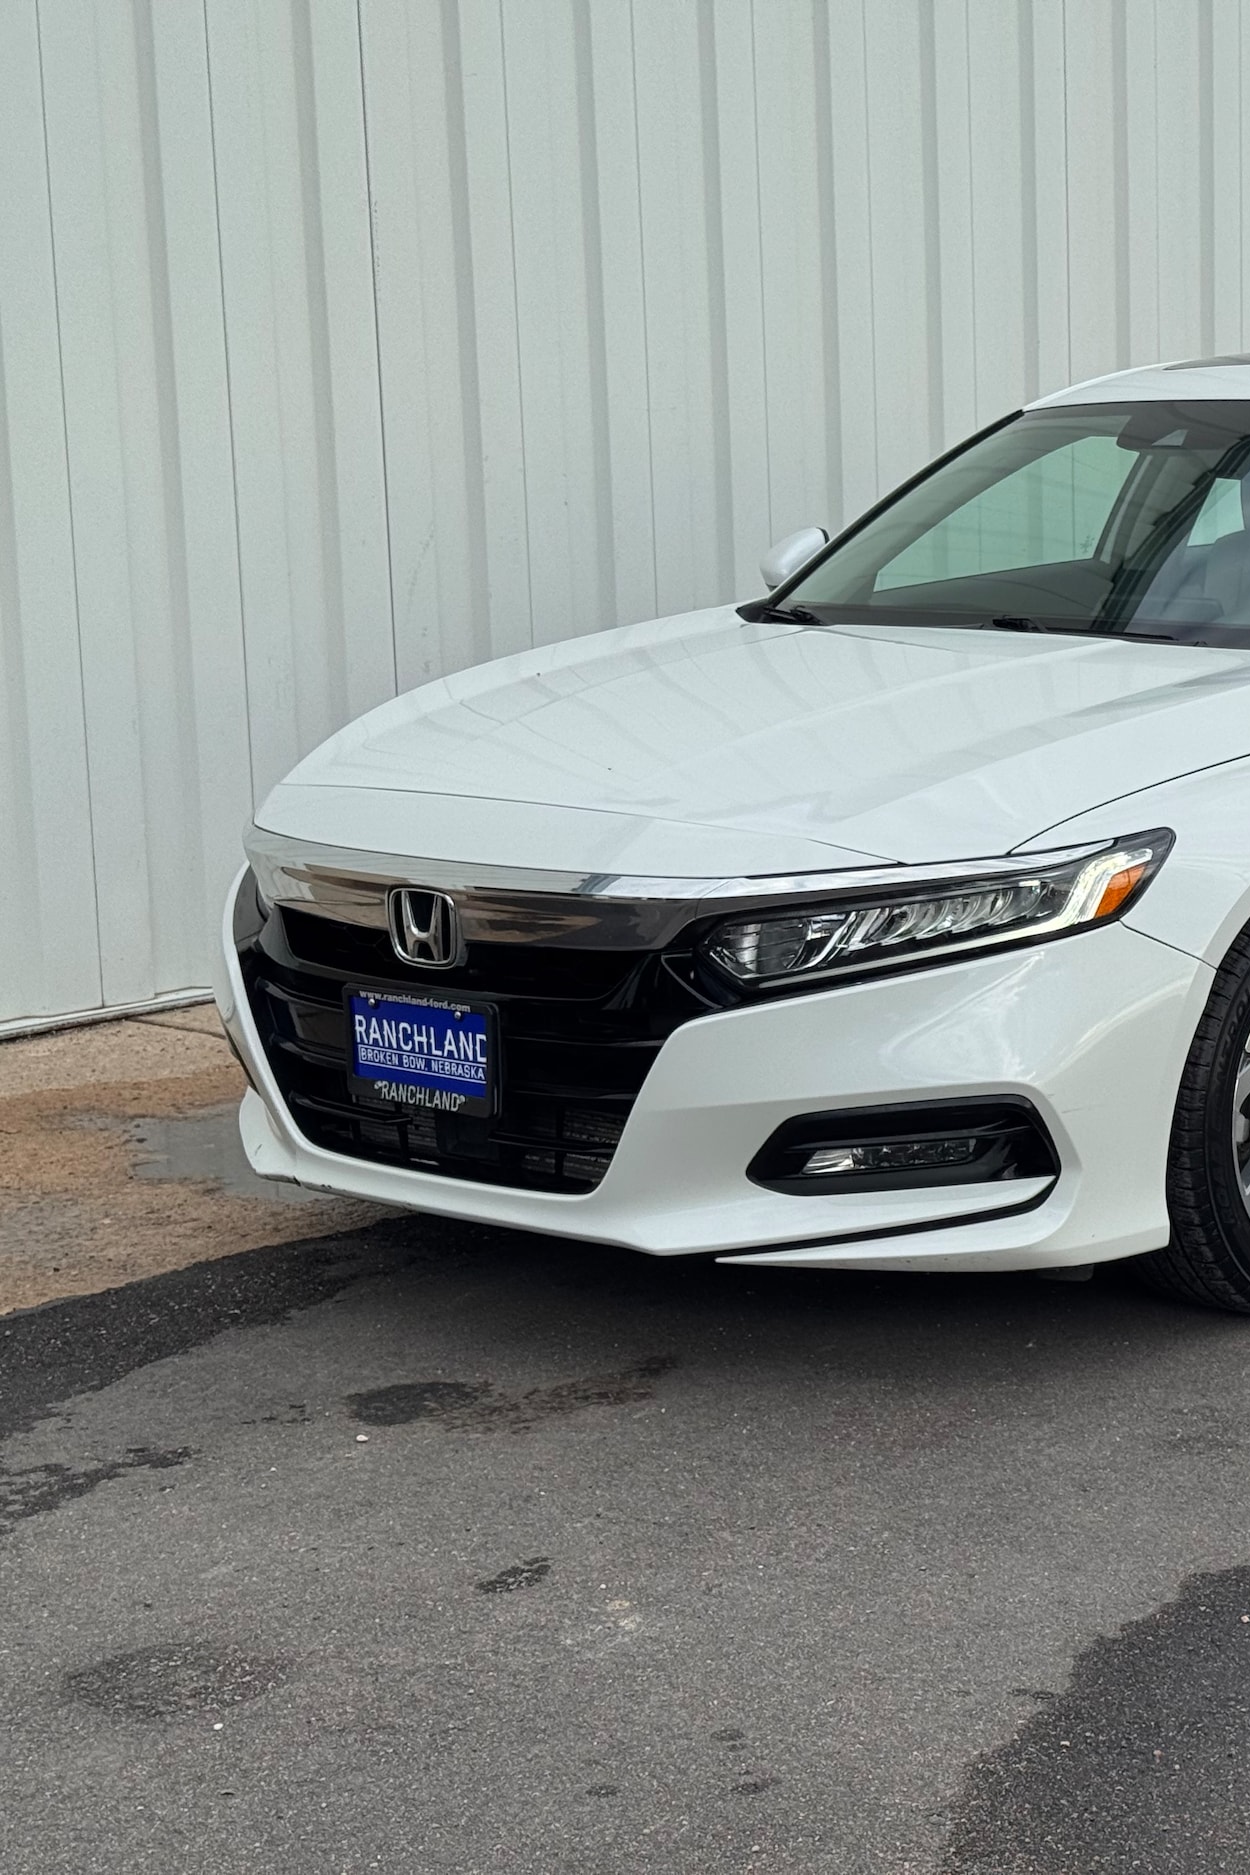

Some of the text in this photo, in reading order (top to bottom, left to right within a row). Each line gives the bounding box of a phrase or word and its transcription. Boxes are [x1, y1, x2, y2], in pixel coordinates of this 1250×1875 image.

[359, 990, 471, 1012] www.ranchland-ford.com
[354, 1015, 487, 1062] RANCHLAND
[361, 1048, 399, 1065] BROKEN
[432, 1061, 485, 1080] NEBRASKA
[380, 1081, 461, 1111] RANCHLAND
